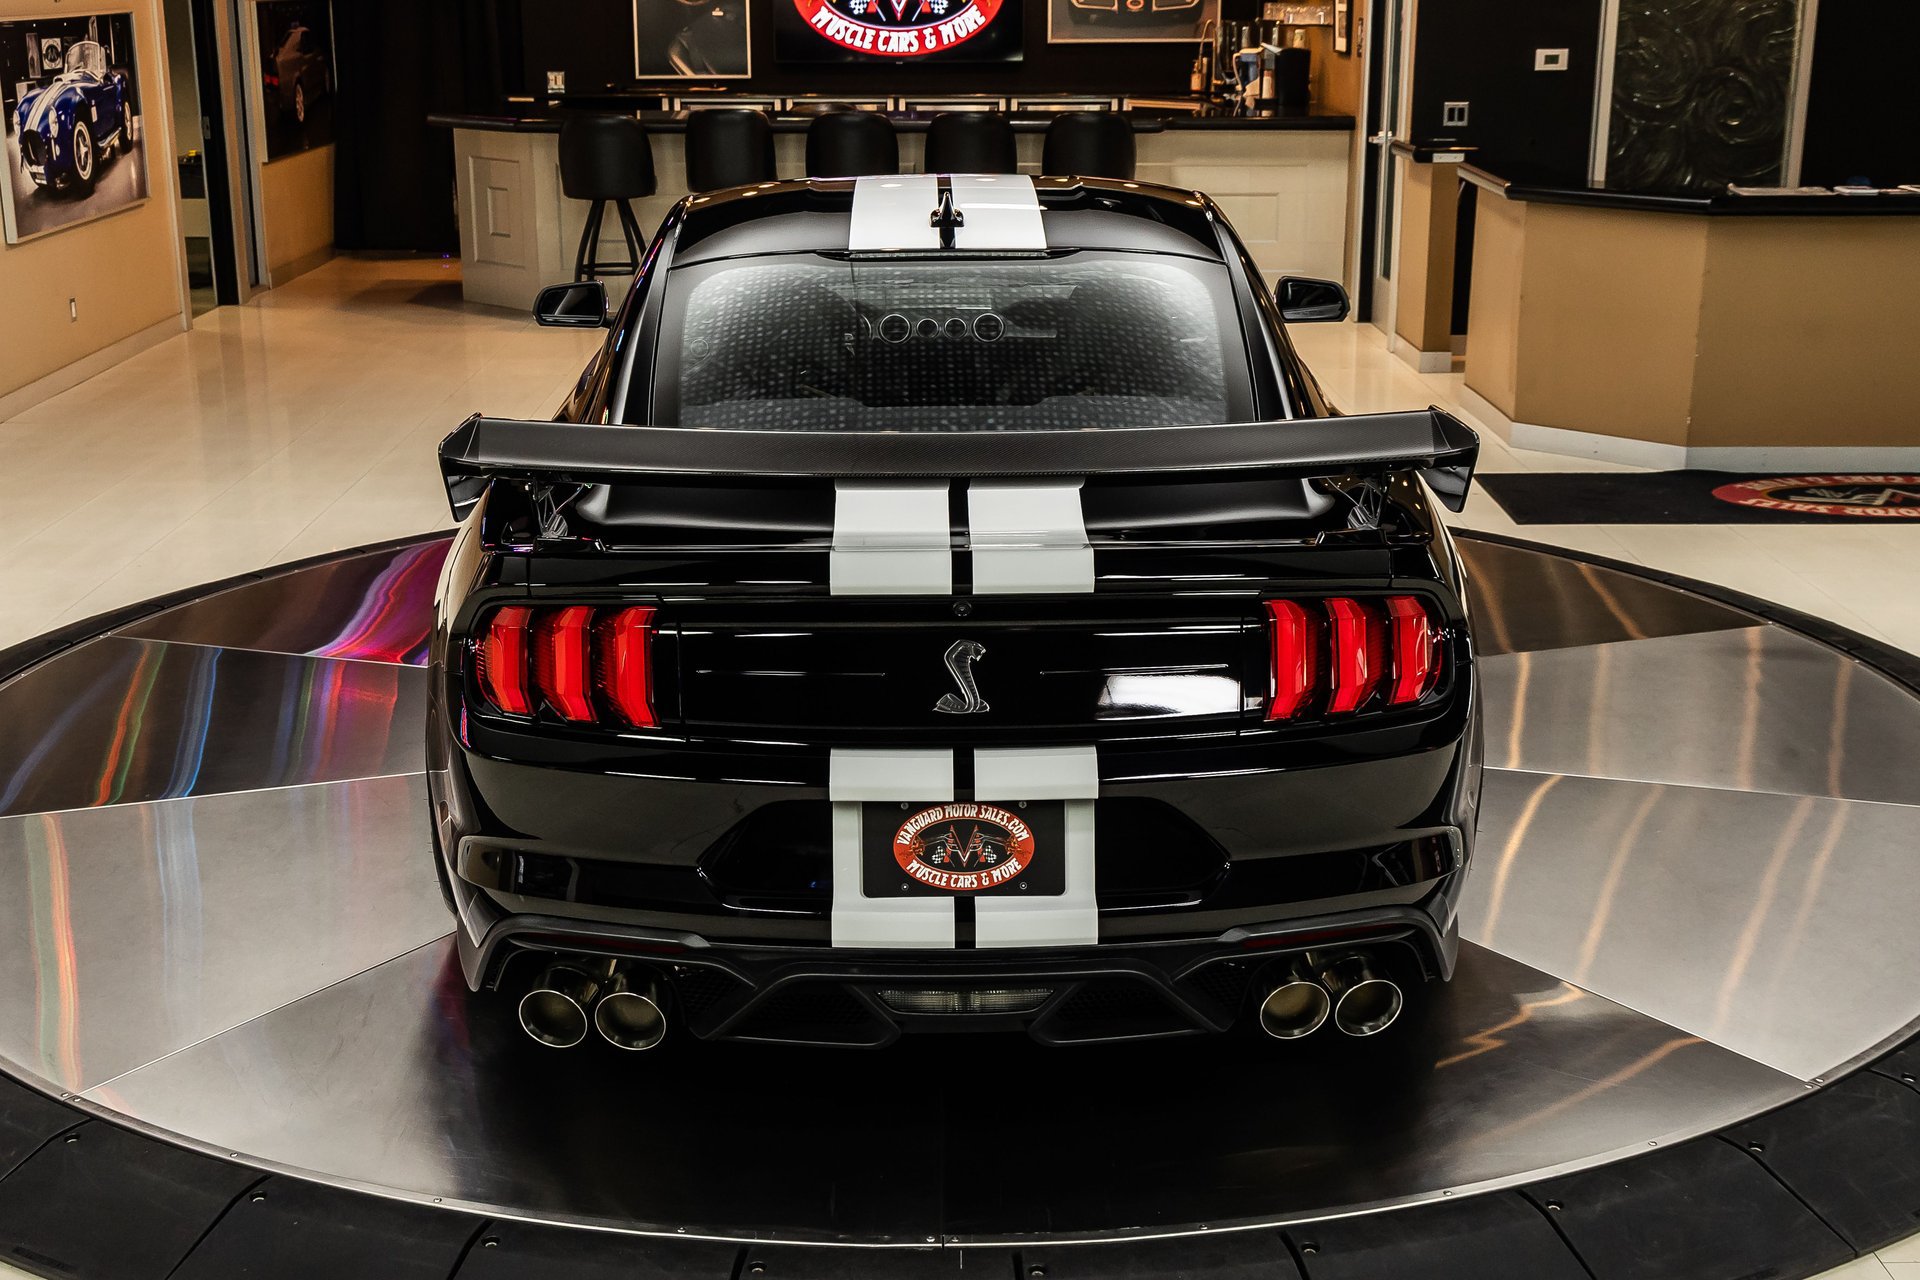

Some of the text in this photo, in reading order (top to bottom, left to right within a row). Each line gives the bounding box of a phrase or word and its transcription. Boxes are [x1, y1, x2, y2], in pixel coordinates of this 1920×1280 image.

[810, 4, 987, 53] MUSCLE CARS & MORE
[896, 803, 1030, 846] VANGUARD MOTOR SALES.COM
[905, 857, 1023, 889] MUSCLE CARS & MORE
